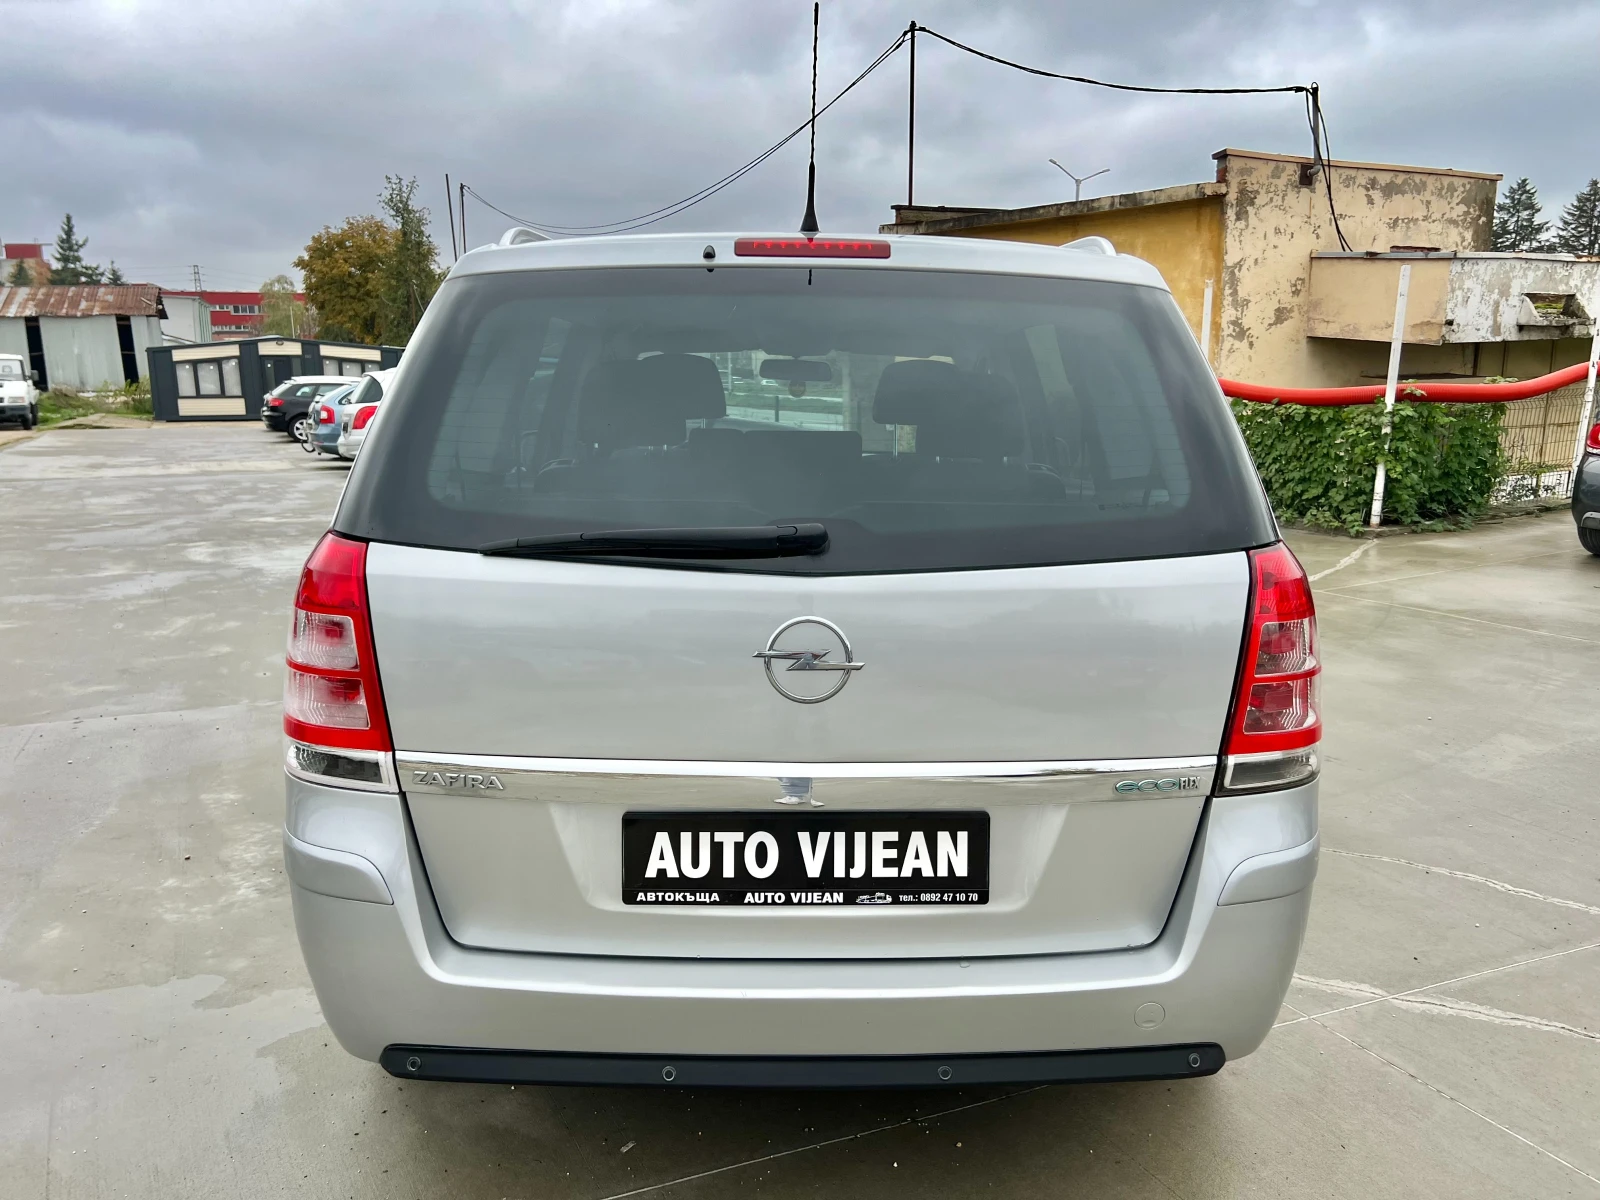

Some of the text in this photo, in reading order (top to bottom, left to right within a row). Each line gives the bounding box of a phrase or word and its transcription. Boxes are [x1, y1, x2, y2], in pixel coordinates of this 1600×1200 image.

[413, 770, 504, 790] ZAFIRA
[644, 830, 969, 879] AUTO VIJEAN
[636, 892, 720, 904] АВТОКЪЩА
[743, 892, 844, 904] AUTO VIJEAN
[920, 892, 941, 902] 0892
[942, 892, 954, 902] 47
[955, 892, 966, 902] 10
[967, 892, 979, 902] 70
